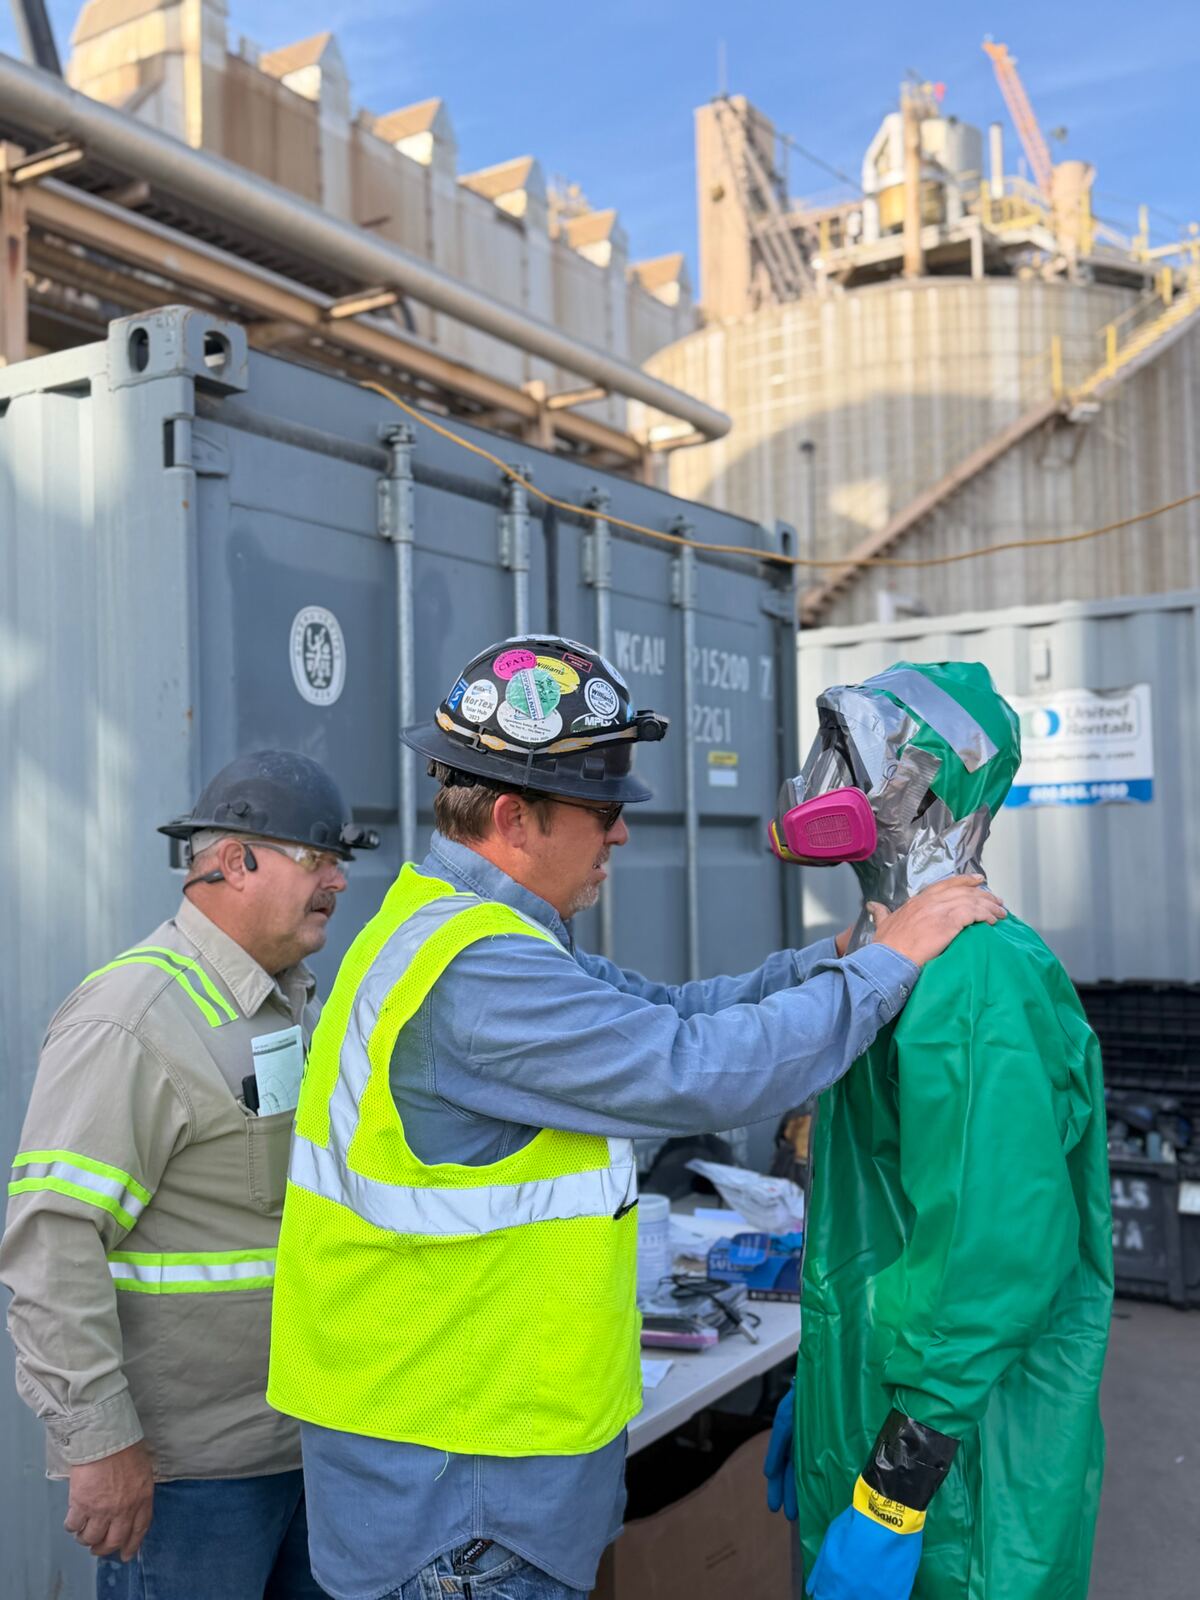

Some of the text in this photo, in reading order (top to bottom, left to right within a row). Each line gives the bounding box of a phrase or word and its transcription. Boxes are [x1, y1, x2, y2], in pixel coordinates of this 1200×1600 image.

[498, 655, 533, 671] CFATS
[536, 662, 565, 675] Williams
[464, 695, 495, 710] NorTex
[464, 1541, 483, 1561] ARIAT
